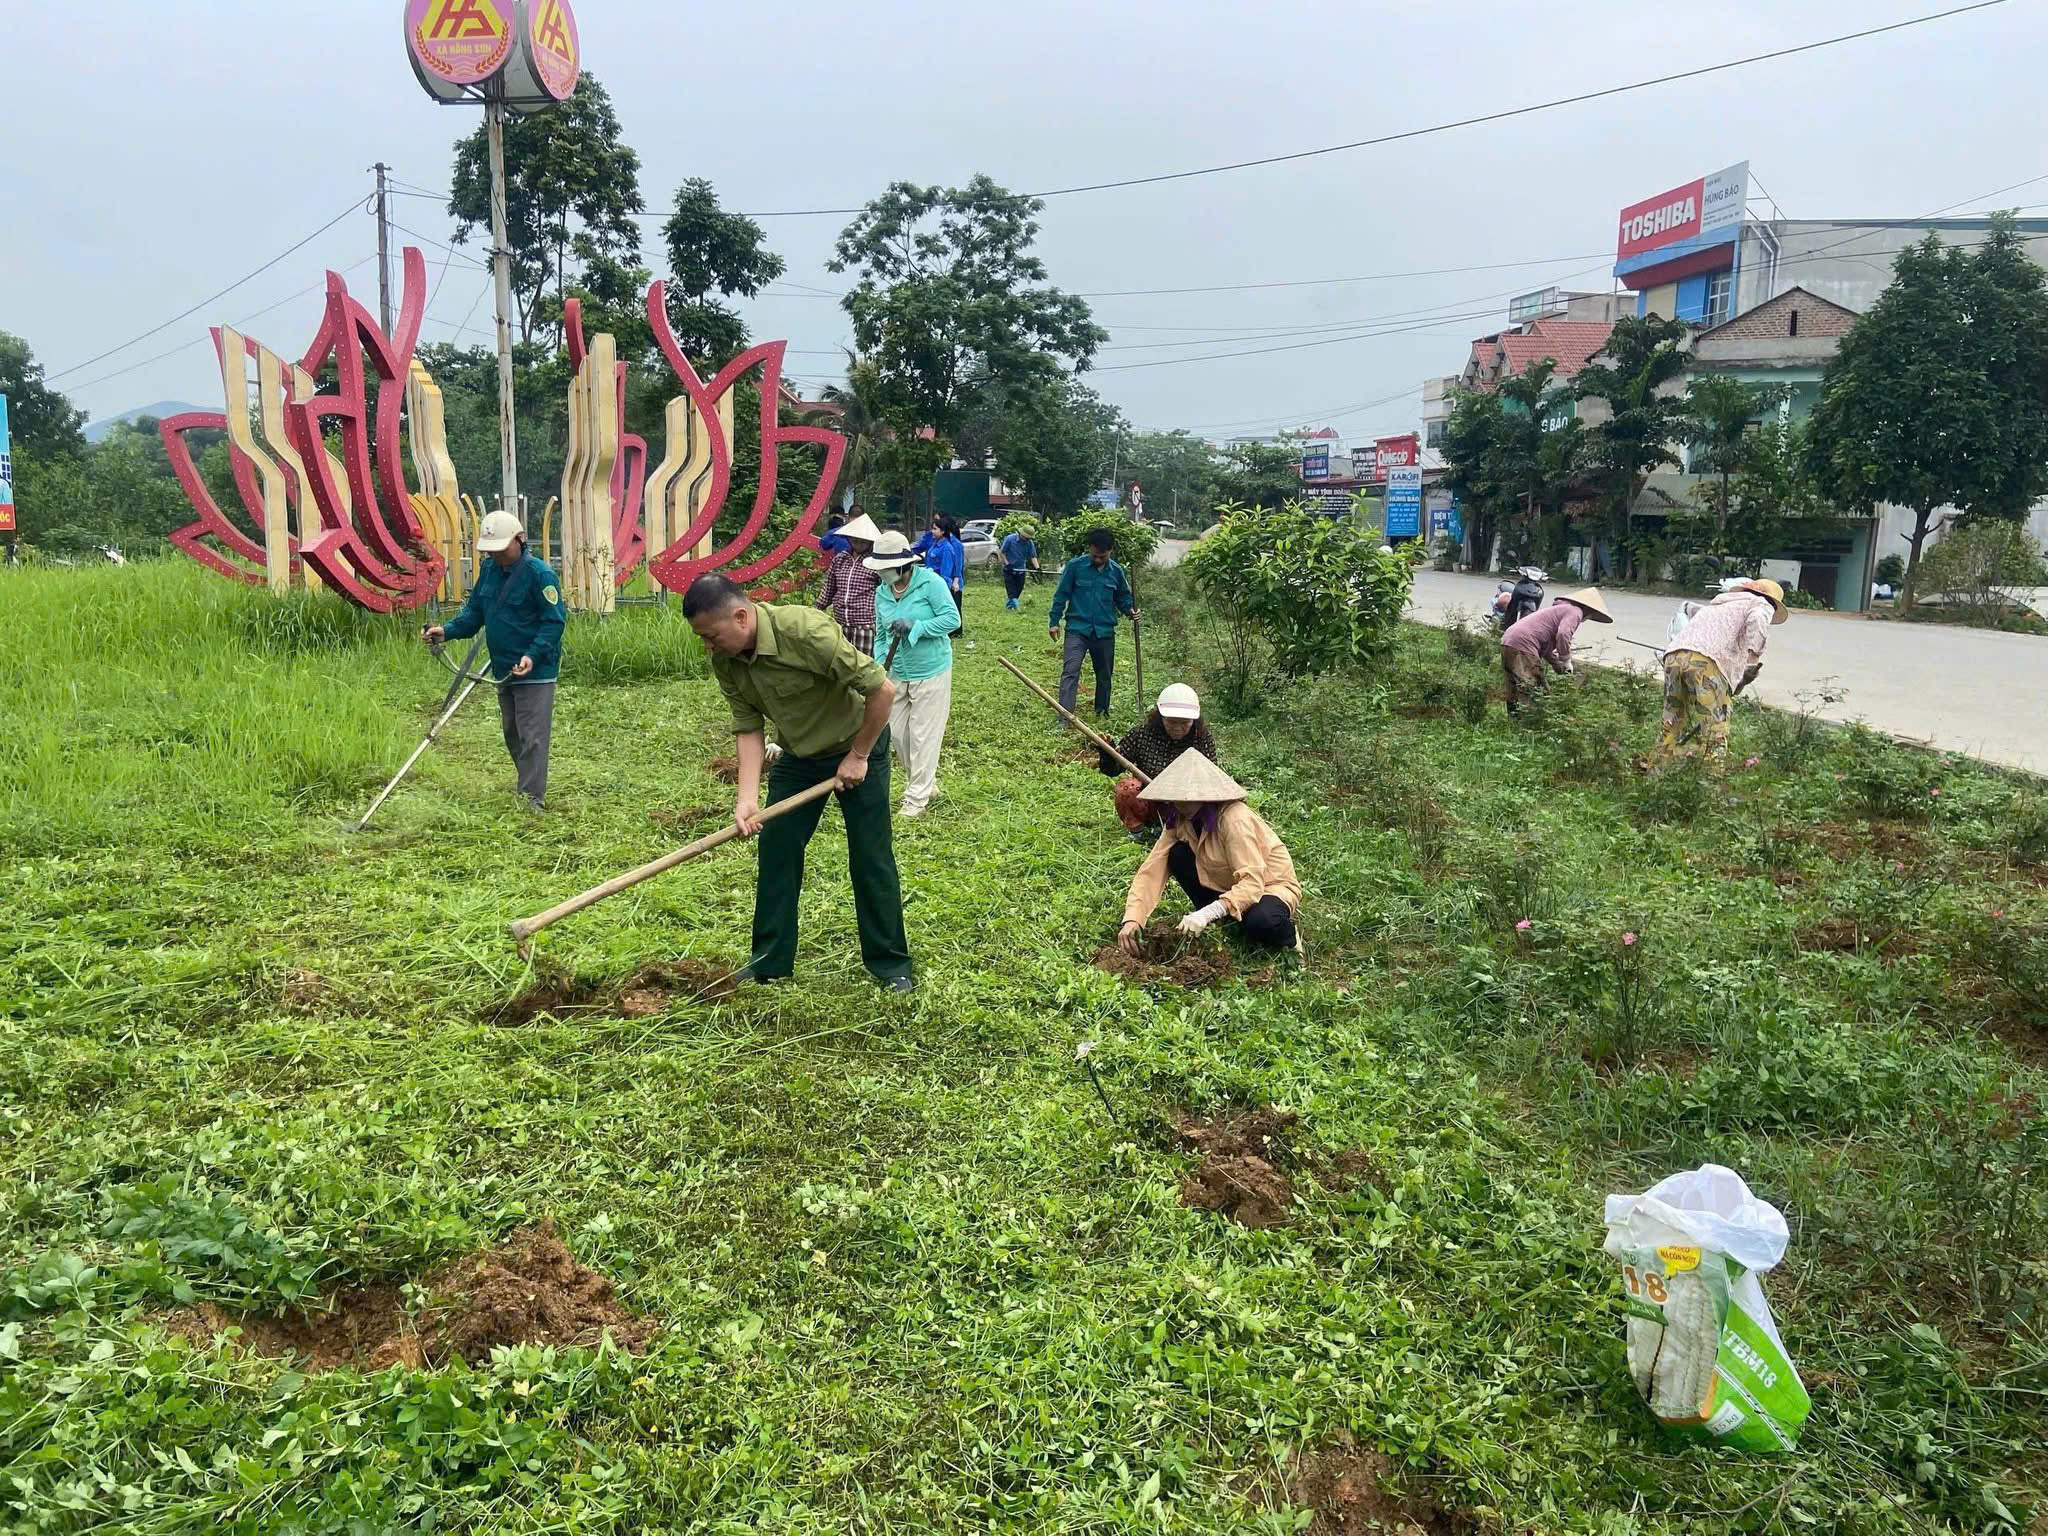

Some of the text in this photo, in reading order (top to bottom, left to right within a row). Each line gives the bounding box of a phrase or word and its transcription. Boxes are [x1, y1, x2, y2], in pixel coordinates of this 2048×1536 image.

[1622, 196, 1697, 245] TOSHIBA
[1624, 1266, 1668, 1304] 18
[1724, 1330, 1777, 1388] TBM18
